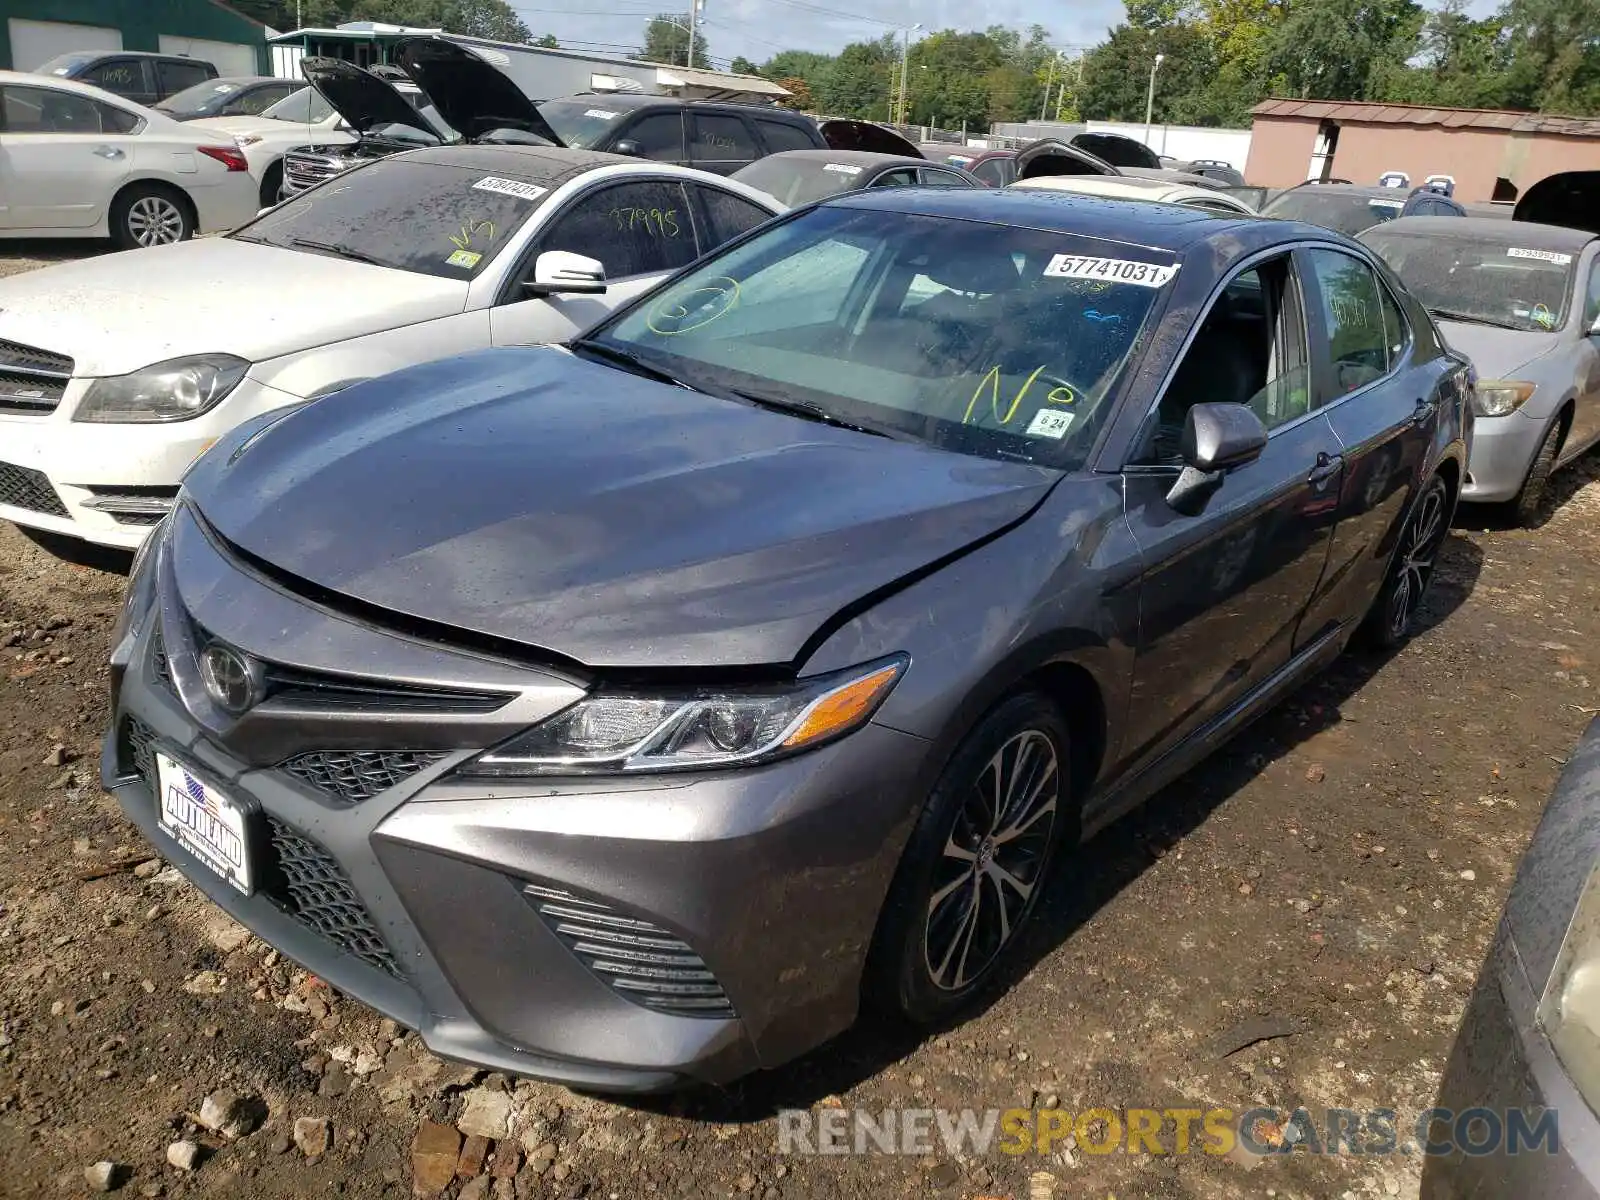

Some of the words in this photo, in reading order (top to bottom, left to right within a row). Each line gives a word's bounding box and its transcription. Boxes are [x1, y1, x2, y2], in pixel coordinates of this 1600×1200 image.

[1060, 257, 1160, 283] 57741031
[1050, 418, 1066, 429] 24
[167, 786, 242, 868] AUTOLAND
